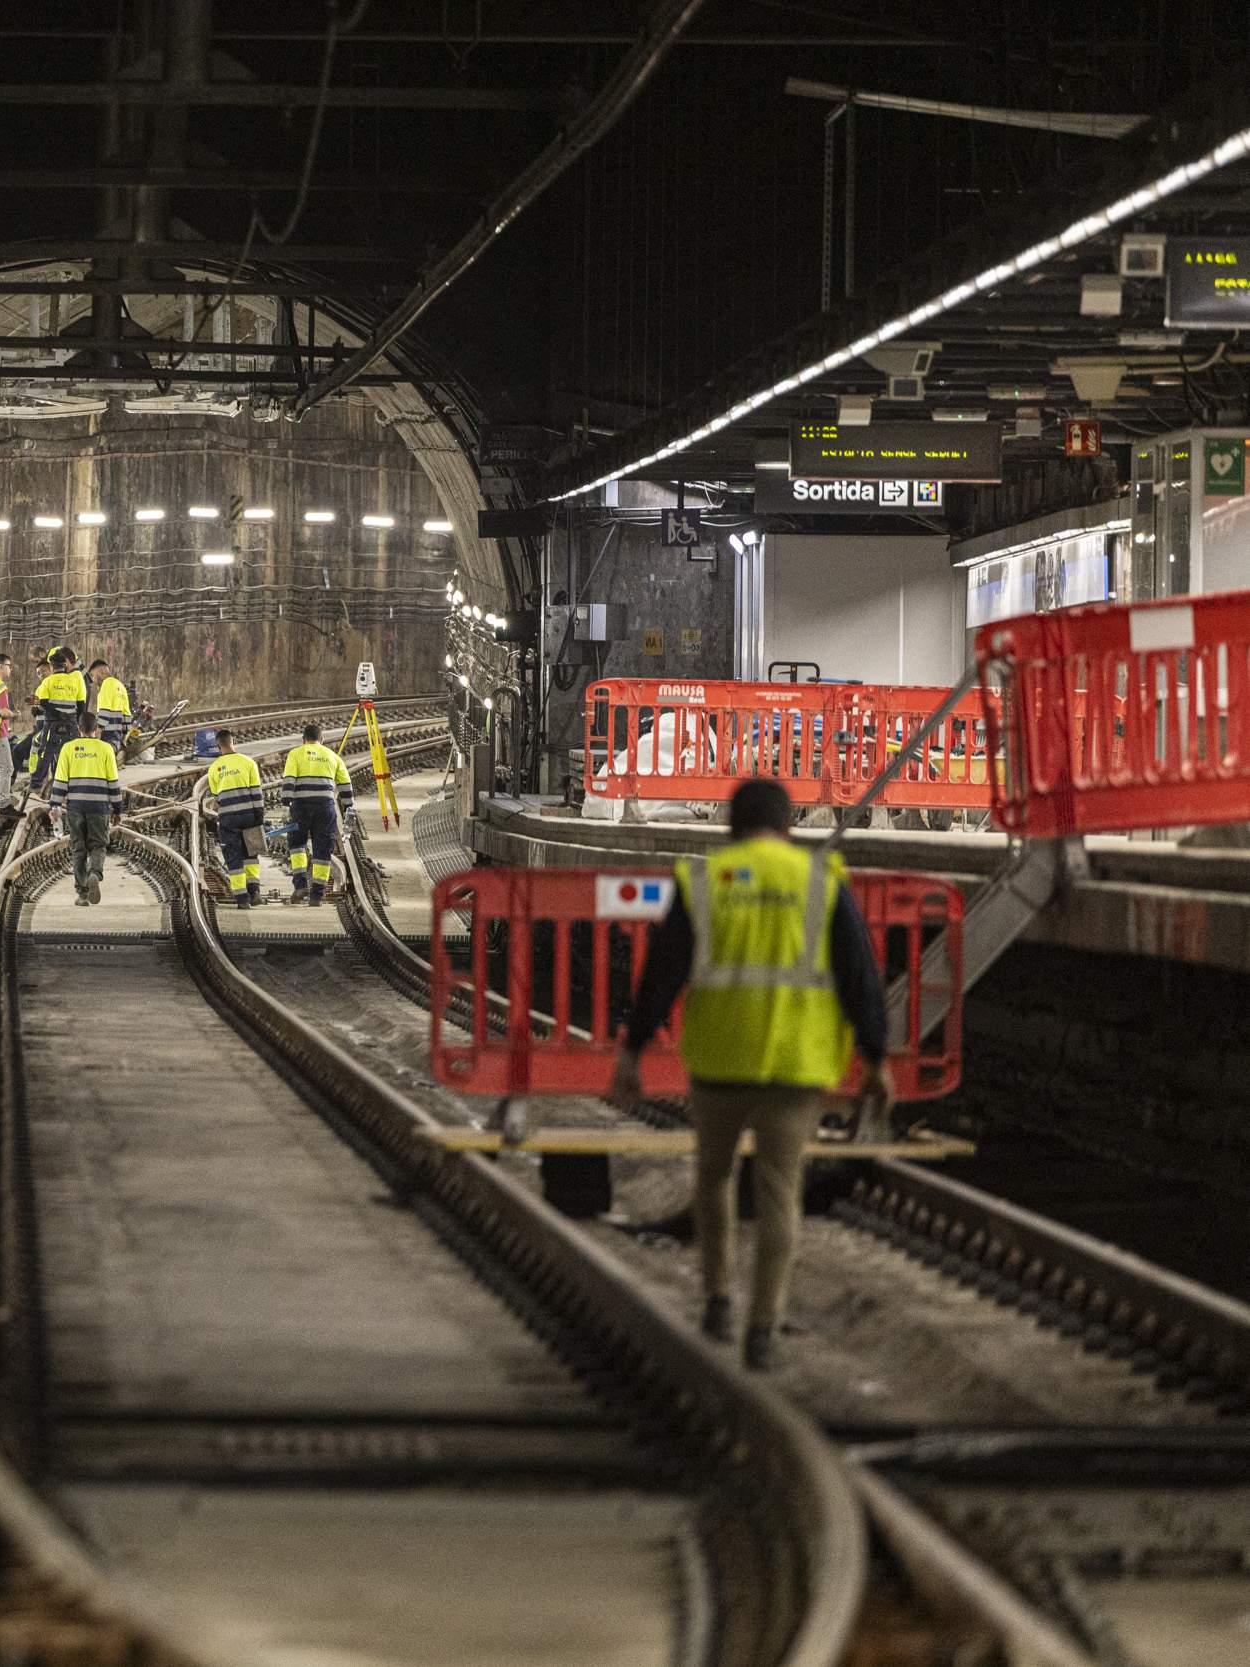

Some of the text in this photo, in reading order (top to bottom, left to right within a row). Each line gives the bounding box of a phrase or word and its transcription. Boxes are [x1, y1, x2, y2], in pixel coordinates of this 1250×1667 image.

[793, 481, 874, 501] Sortida
[658, 684, 705, 697] MAUSA
[74, 752, 98, 760] COMSA
[308, 756, 330, 764] COMSA
[219, 768, 240, 779] COMSA
